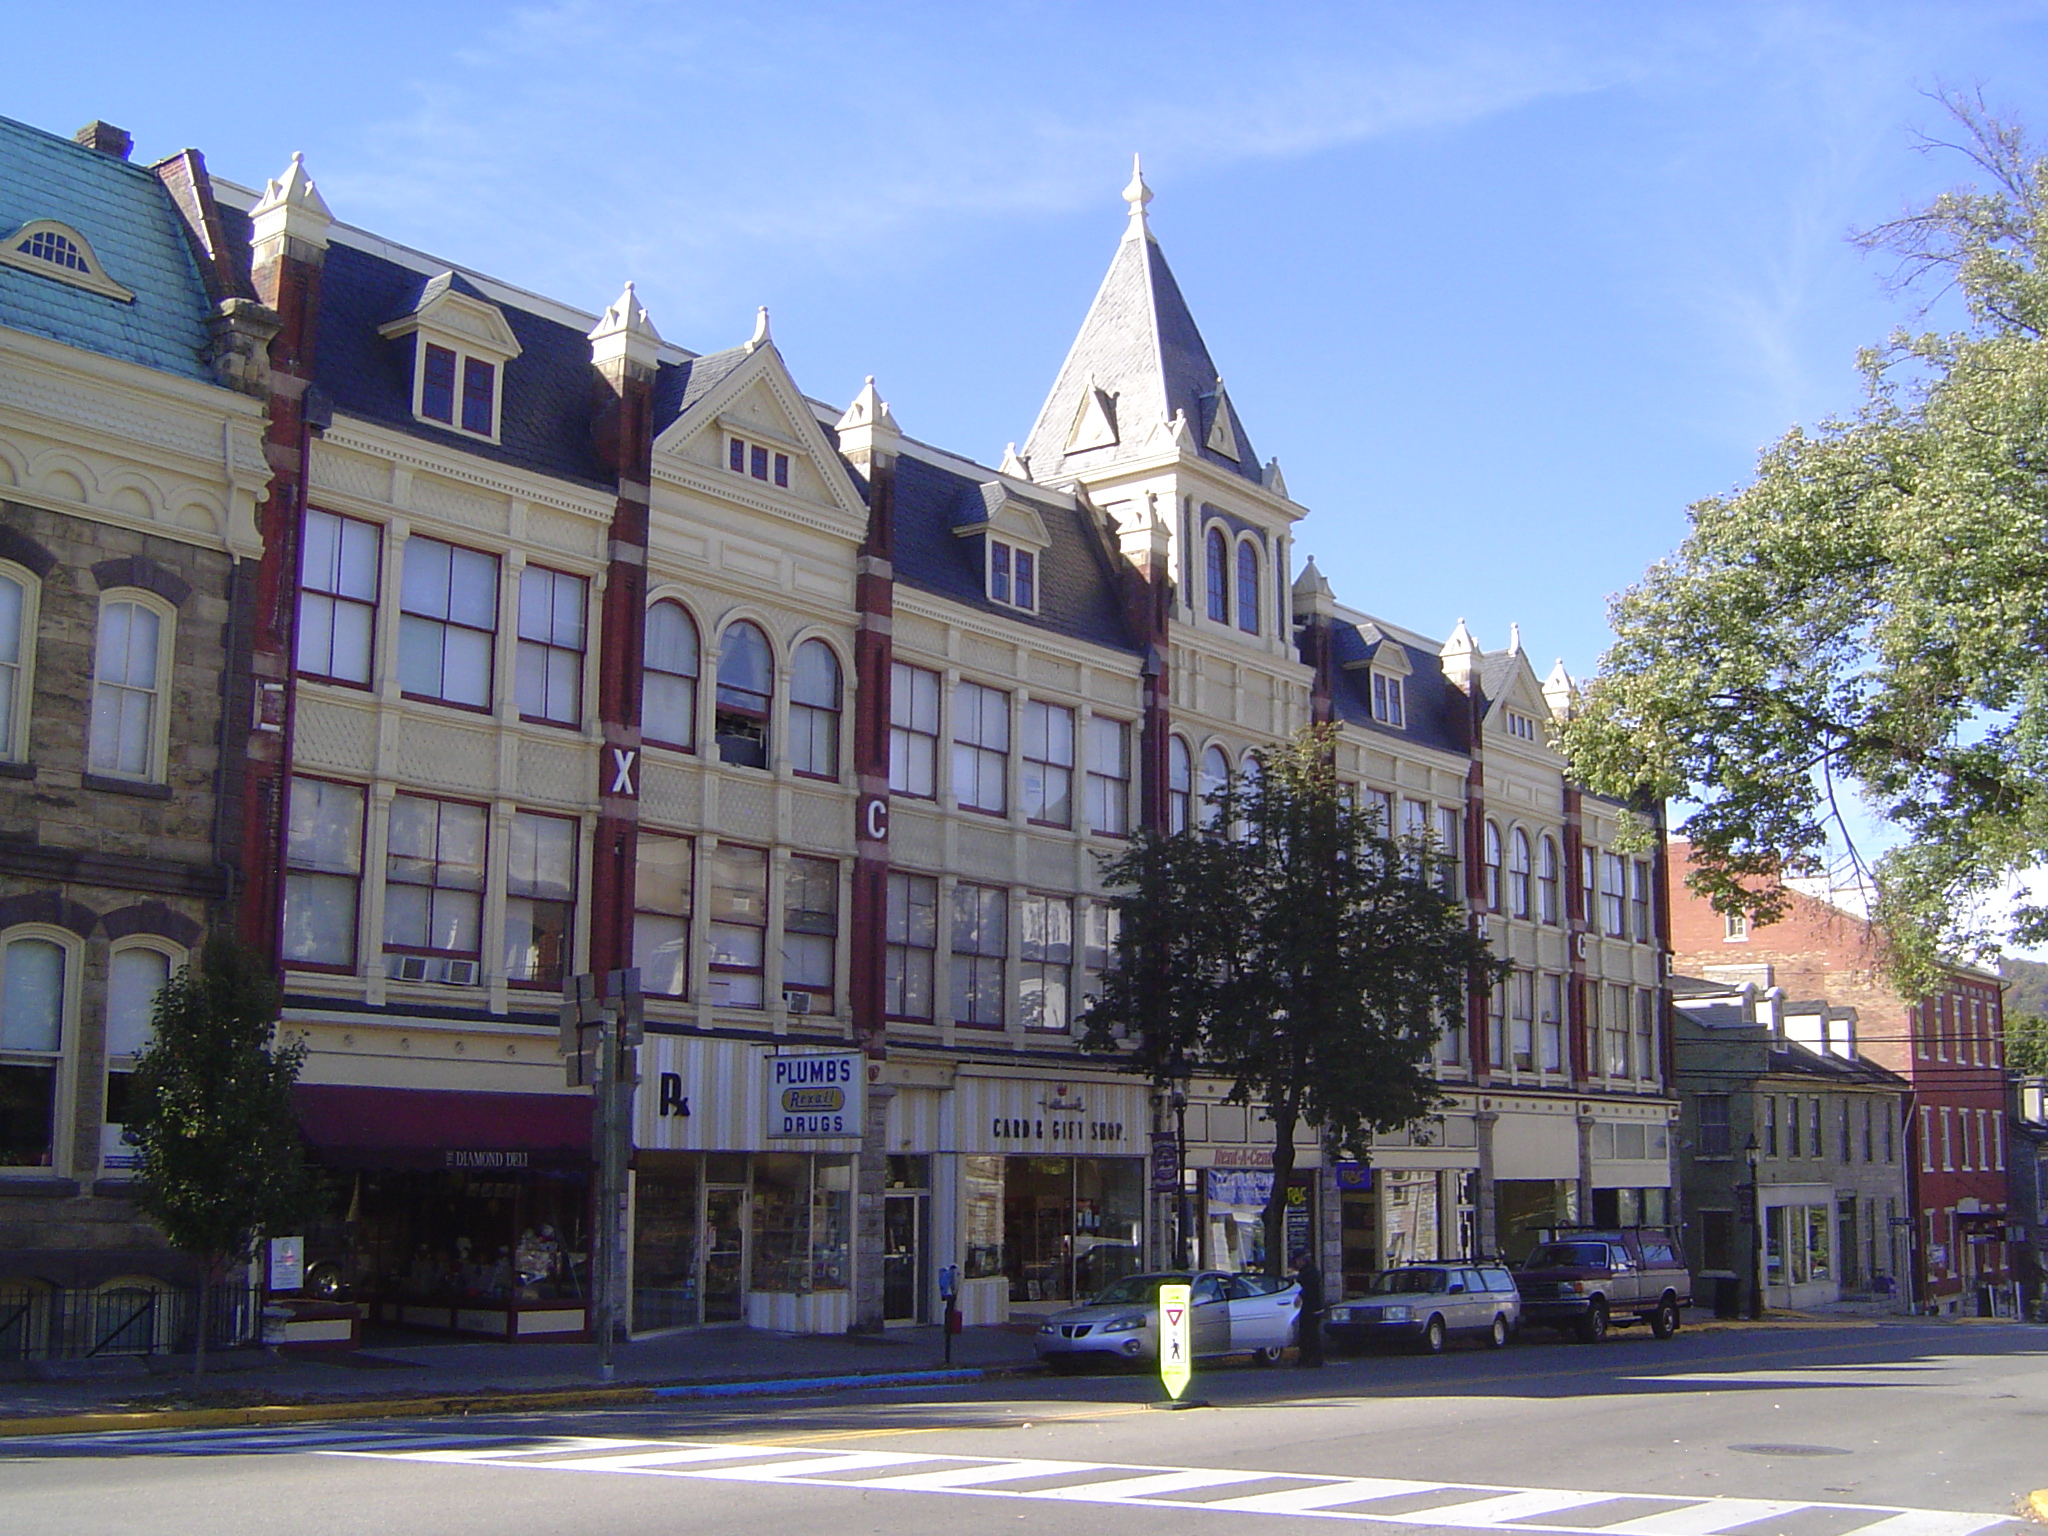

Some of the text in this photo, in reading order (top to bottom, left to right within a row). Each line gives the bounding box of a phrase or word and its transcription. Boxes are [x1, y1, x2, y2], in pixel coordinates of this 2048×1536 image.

[612, 748, 635, 795] X
[867, 800, 886, 839] C
[1577, 934, 1586, 959] G
[1665, 953, 1674, 977] E
[776, 1059, 850, 1084] PLUMB'S
[790, 1089, 835, 1108] Rexall
[783, 1116, 843, 1132] DRUGS
[993, 1118, 1030, 1138] CARD
[1036, 1119, 1043, 1139] &
[1052, 1121, 1083, 1140] GIFT
[456, 1150, 528, 1167] DIAMOND DELI
